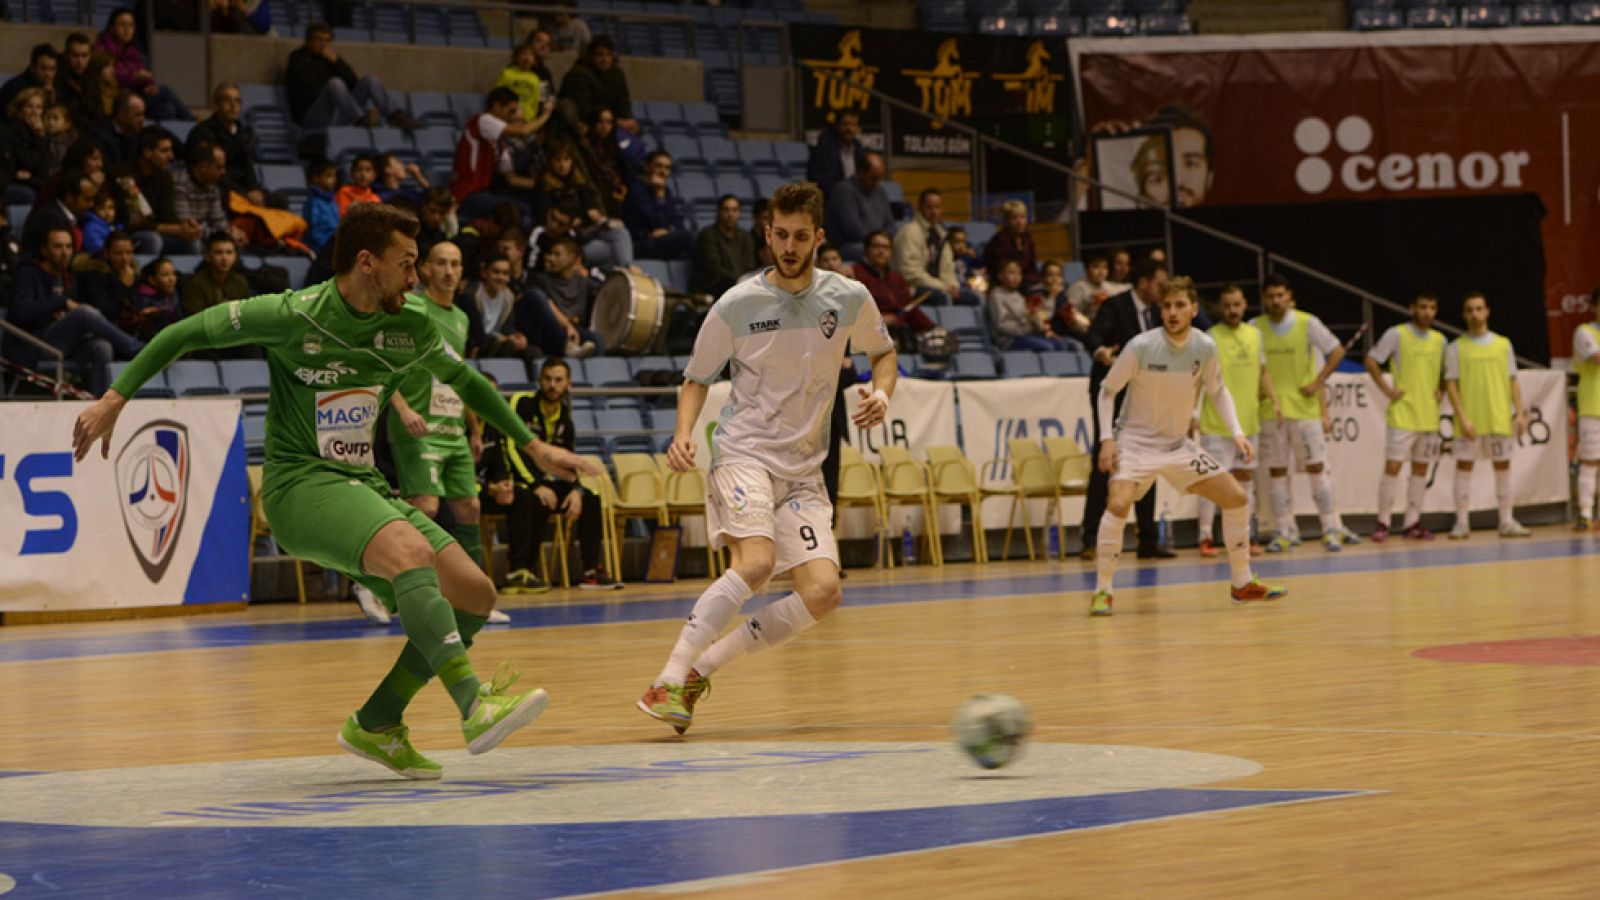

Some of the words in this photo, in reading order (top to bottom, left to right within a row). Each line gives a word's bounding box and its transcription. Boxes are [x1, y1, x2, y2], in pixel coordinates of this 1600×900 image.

[1341, 151, 1530, 192] cenor
[749, 318, 781, 331] STARK
[1190, 453, 1220, 475] 20
[799, 525, 819, 551] 9
